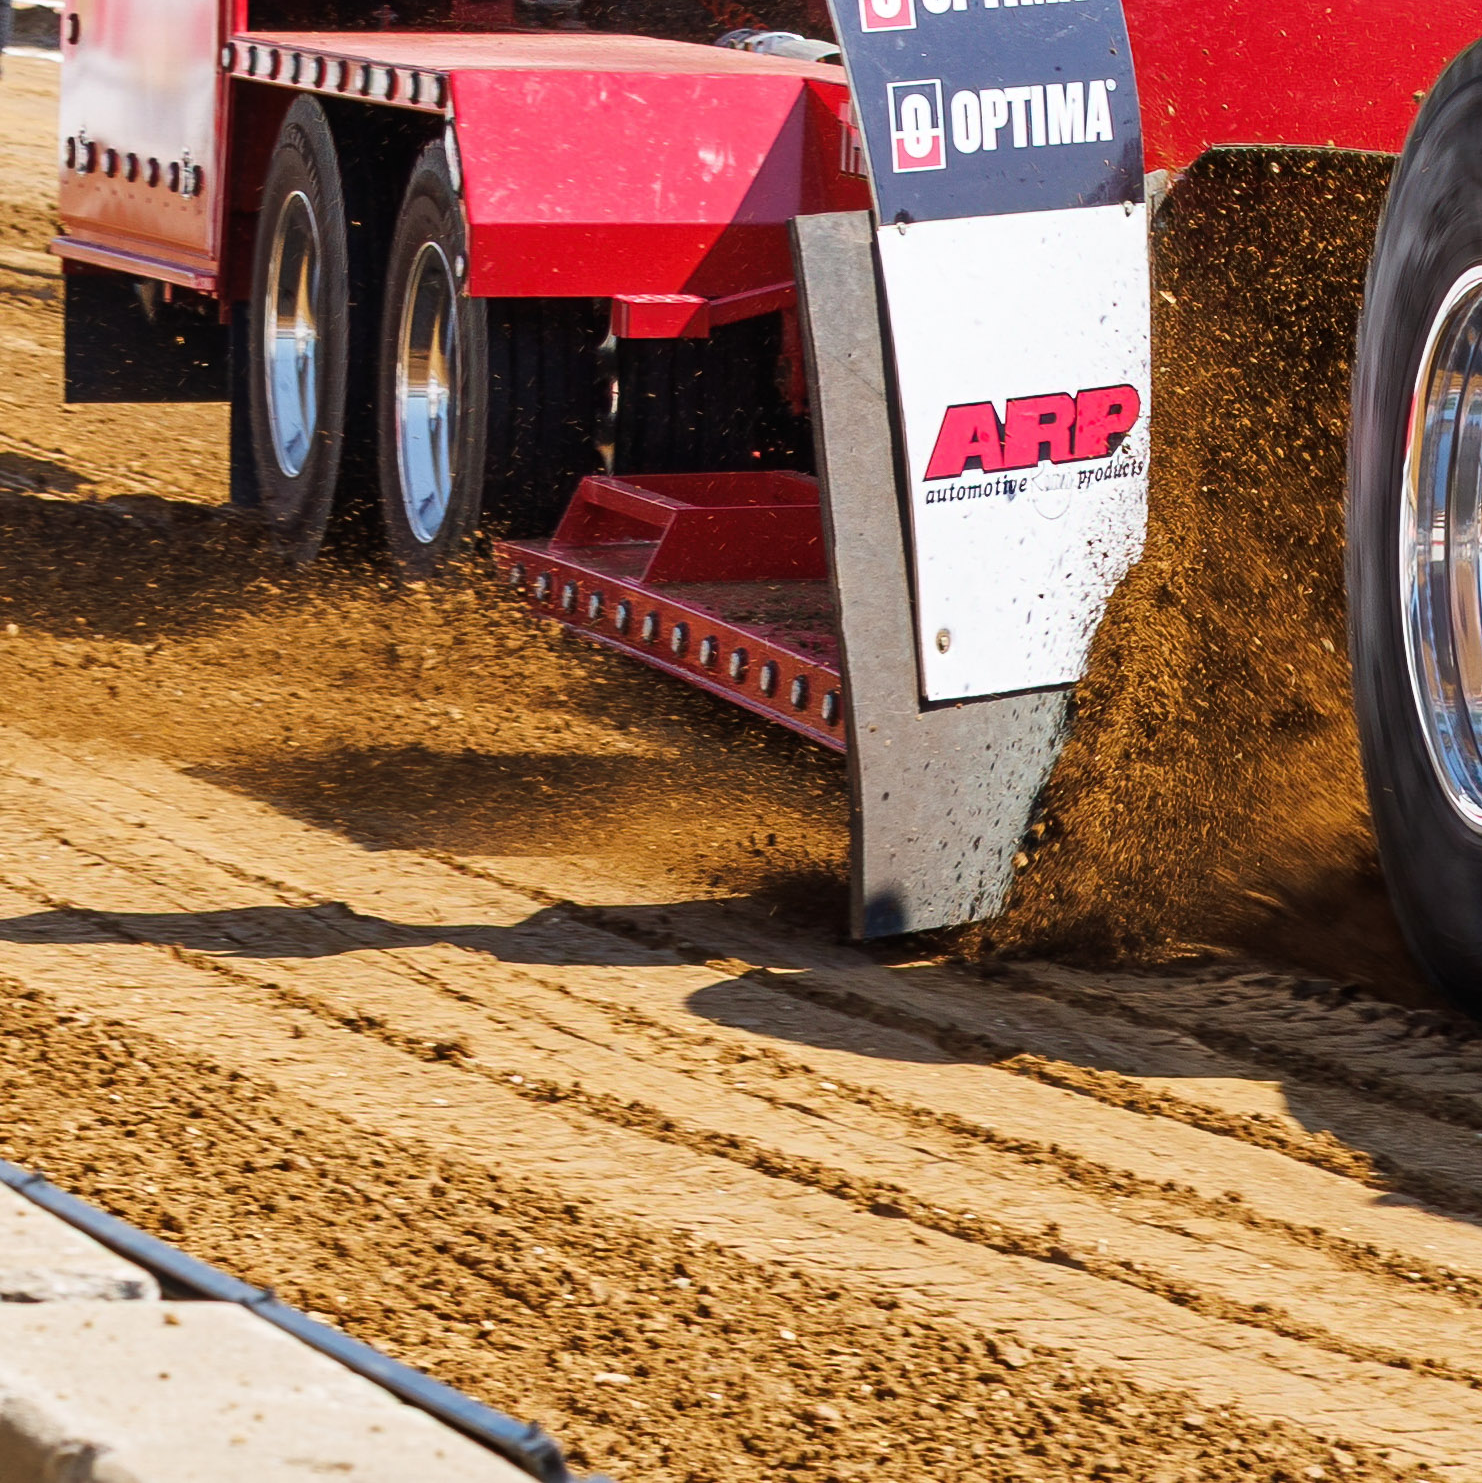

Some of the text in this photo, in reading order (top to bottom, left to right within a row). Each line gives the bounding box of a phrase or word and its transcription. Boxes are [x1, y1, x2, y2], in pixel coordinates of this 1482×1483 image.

[951, 80, 1115, 155] OPTIMA
[924, 384, 1142, 481] ARP
[925, 474, 1028, 505] automotive
[1077, 458, 1144, 491] products
